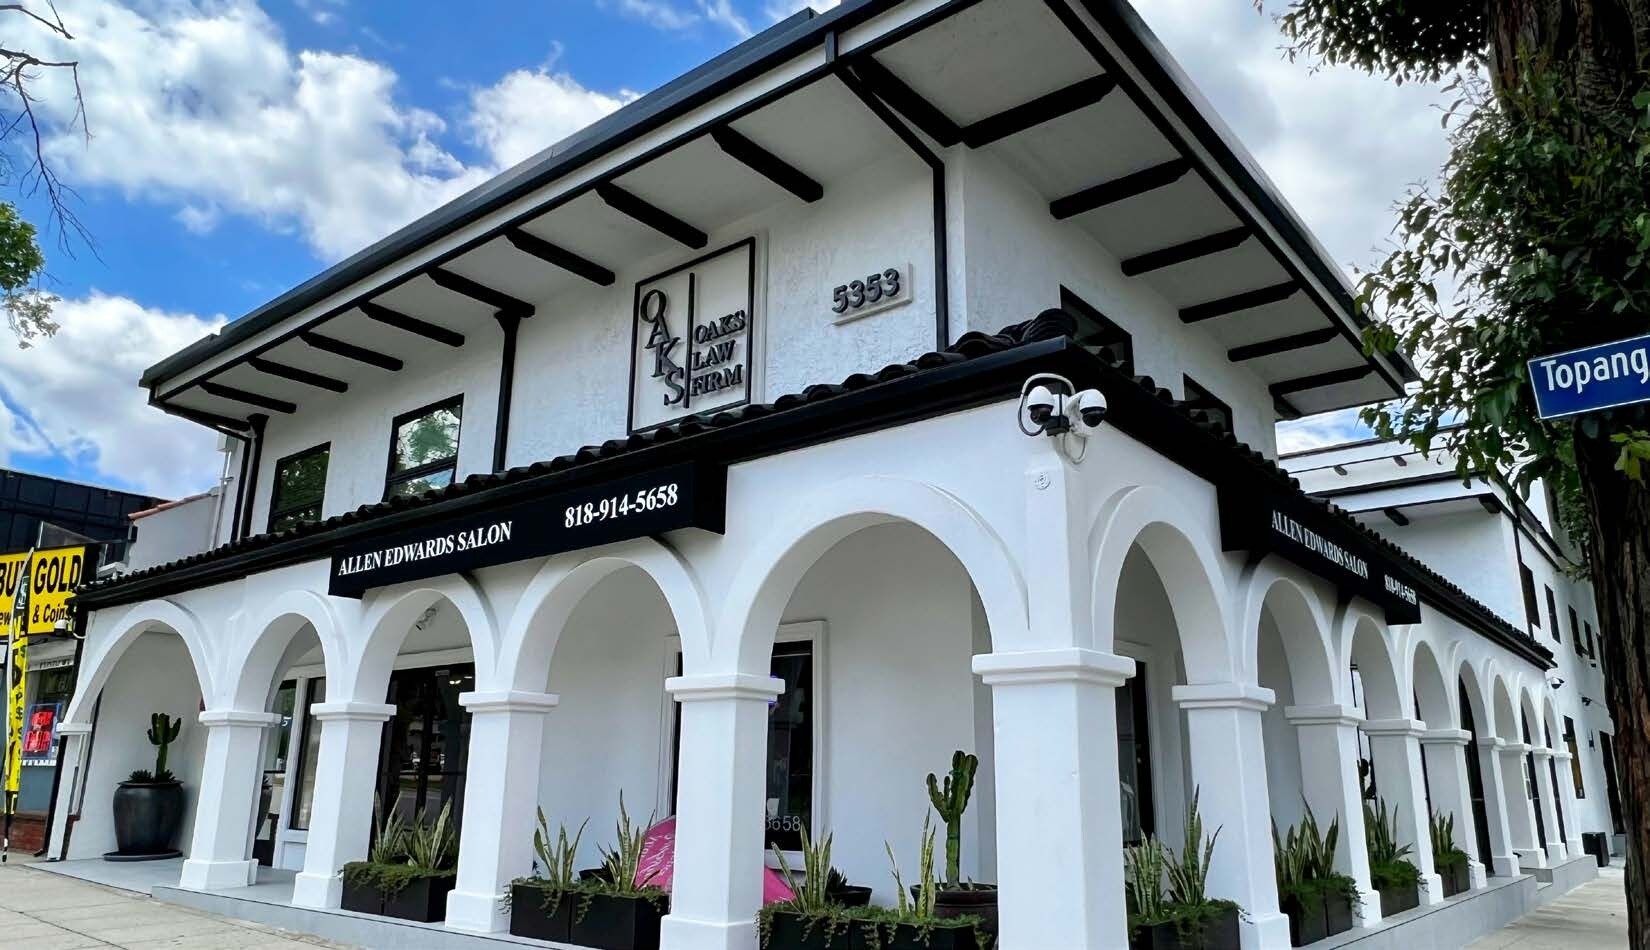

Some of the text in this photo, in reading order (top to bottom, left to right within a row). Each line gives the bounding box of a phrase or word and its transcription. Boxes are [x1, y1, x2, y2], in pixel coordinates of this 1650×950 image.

[831, 268, 900, 314] 5353
[694, 309, 746, 345] OAKS
[691, 339, 737, 371] LAW
[1540, 348, 1649, 394] Topang
[690, 363, 743, 397] FIRM
[564, 483, 678, 528] 818-914-5658
[338, 520, 513, 576] ALLEN EDWARDS SALON
[1271, 509, 1369, 580] ALLEN EDWARDS SALON
[33, 554, 82, 595] GOLD
[32, 604, 40, 624] &
